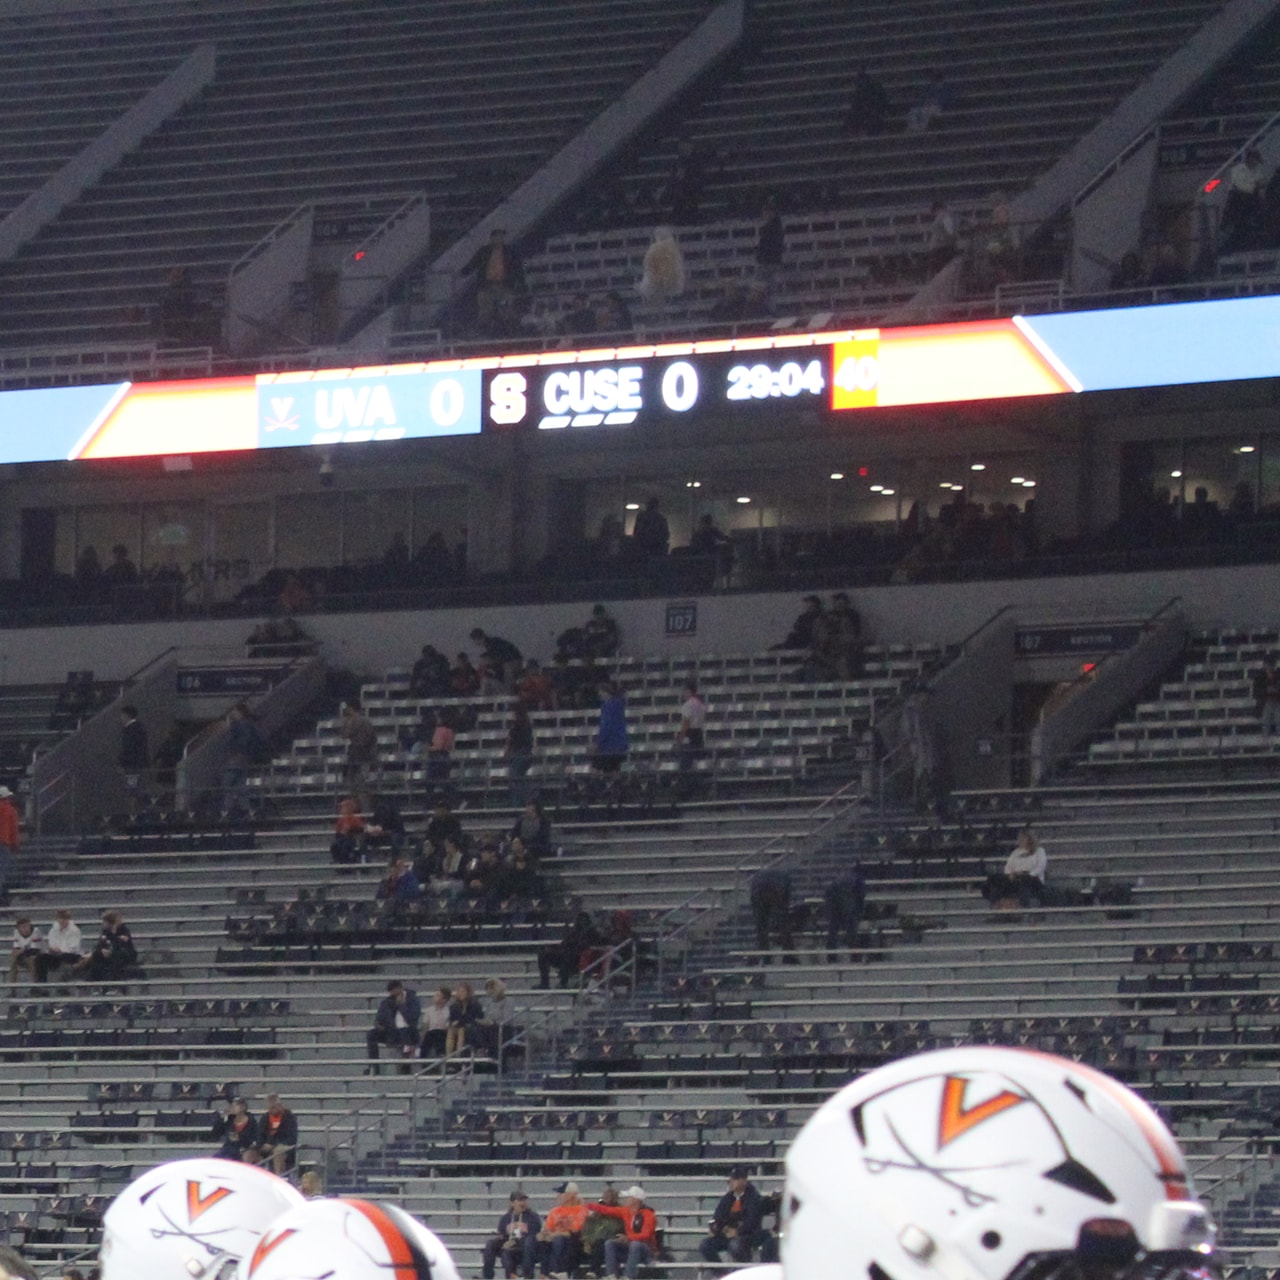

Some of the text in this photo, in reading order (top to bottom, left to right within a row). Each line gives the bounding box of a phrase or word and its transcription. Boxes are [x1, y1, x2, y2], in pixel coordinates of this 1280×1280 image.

[314, 378, 465, 430] UVA 0
[542, 366, 644, 418] CUSE
[661, 360, 700, 412] 0
[726, 359, 826, 402] 29:04
[669, 615, 694, 630] 107
